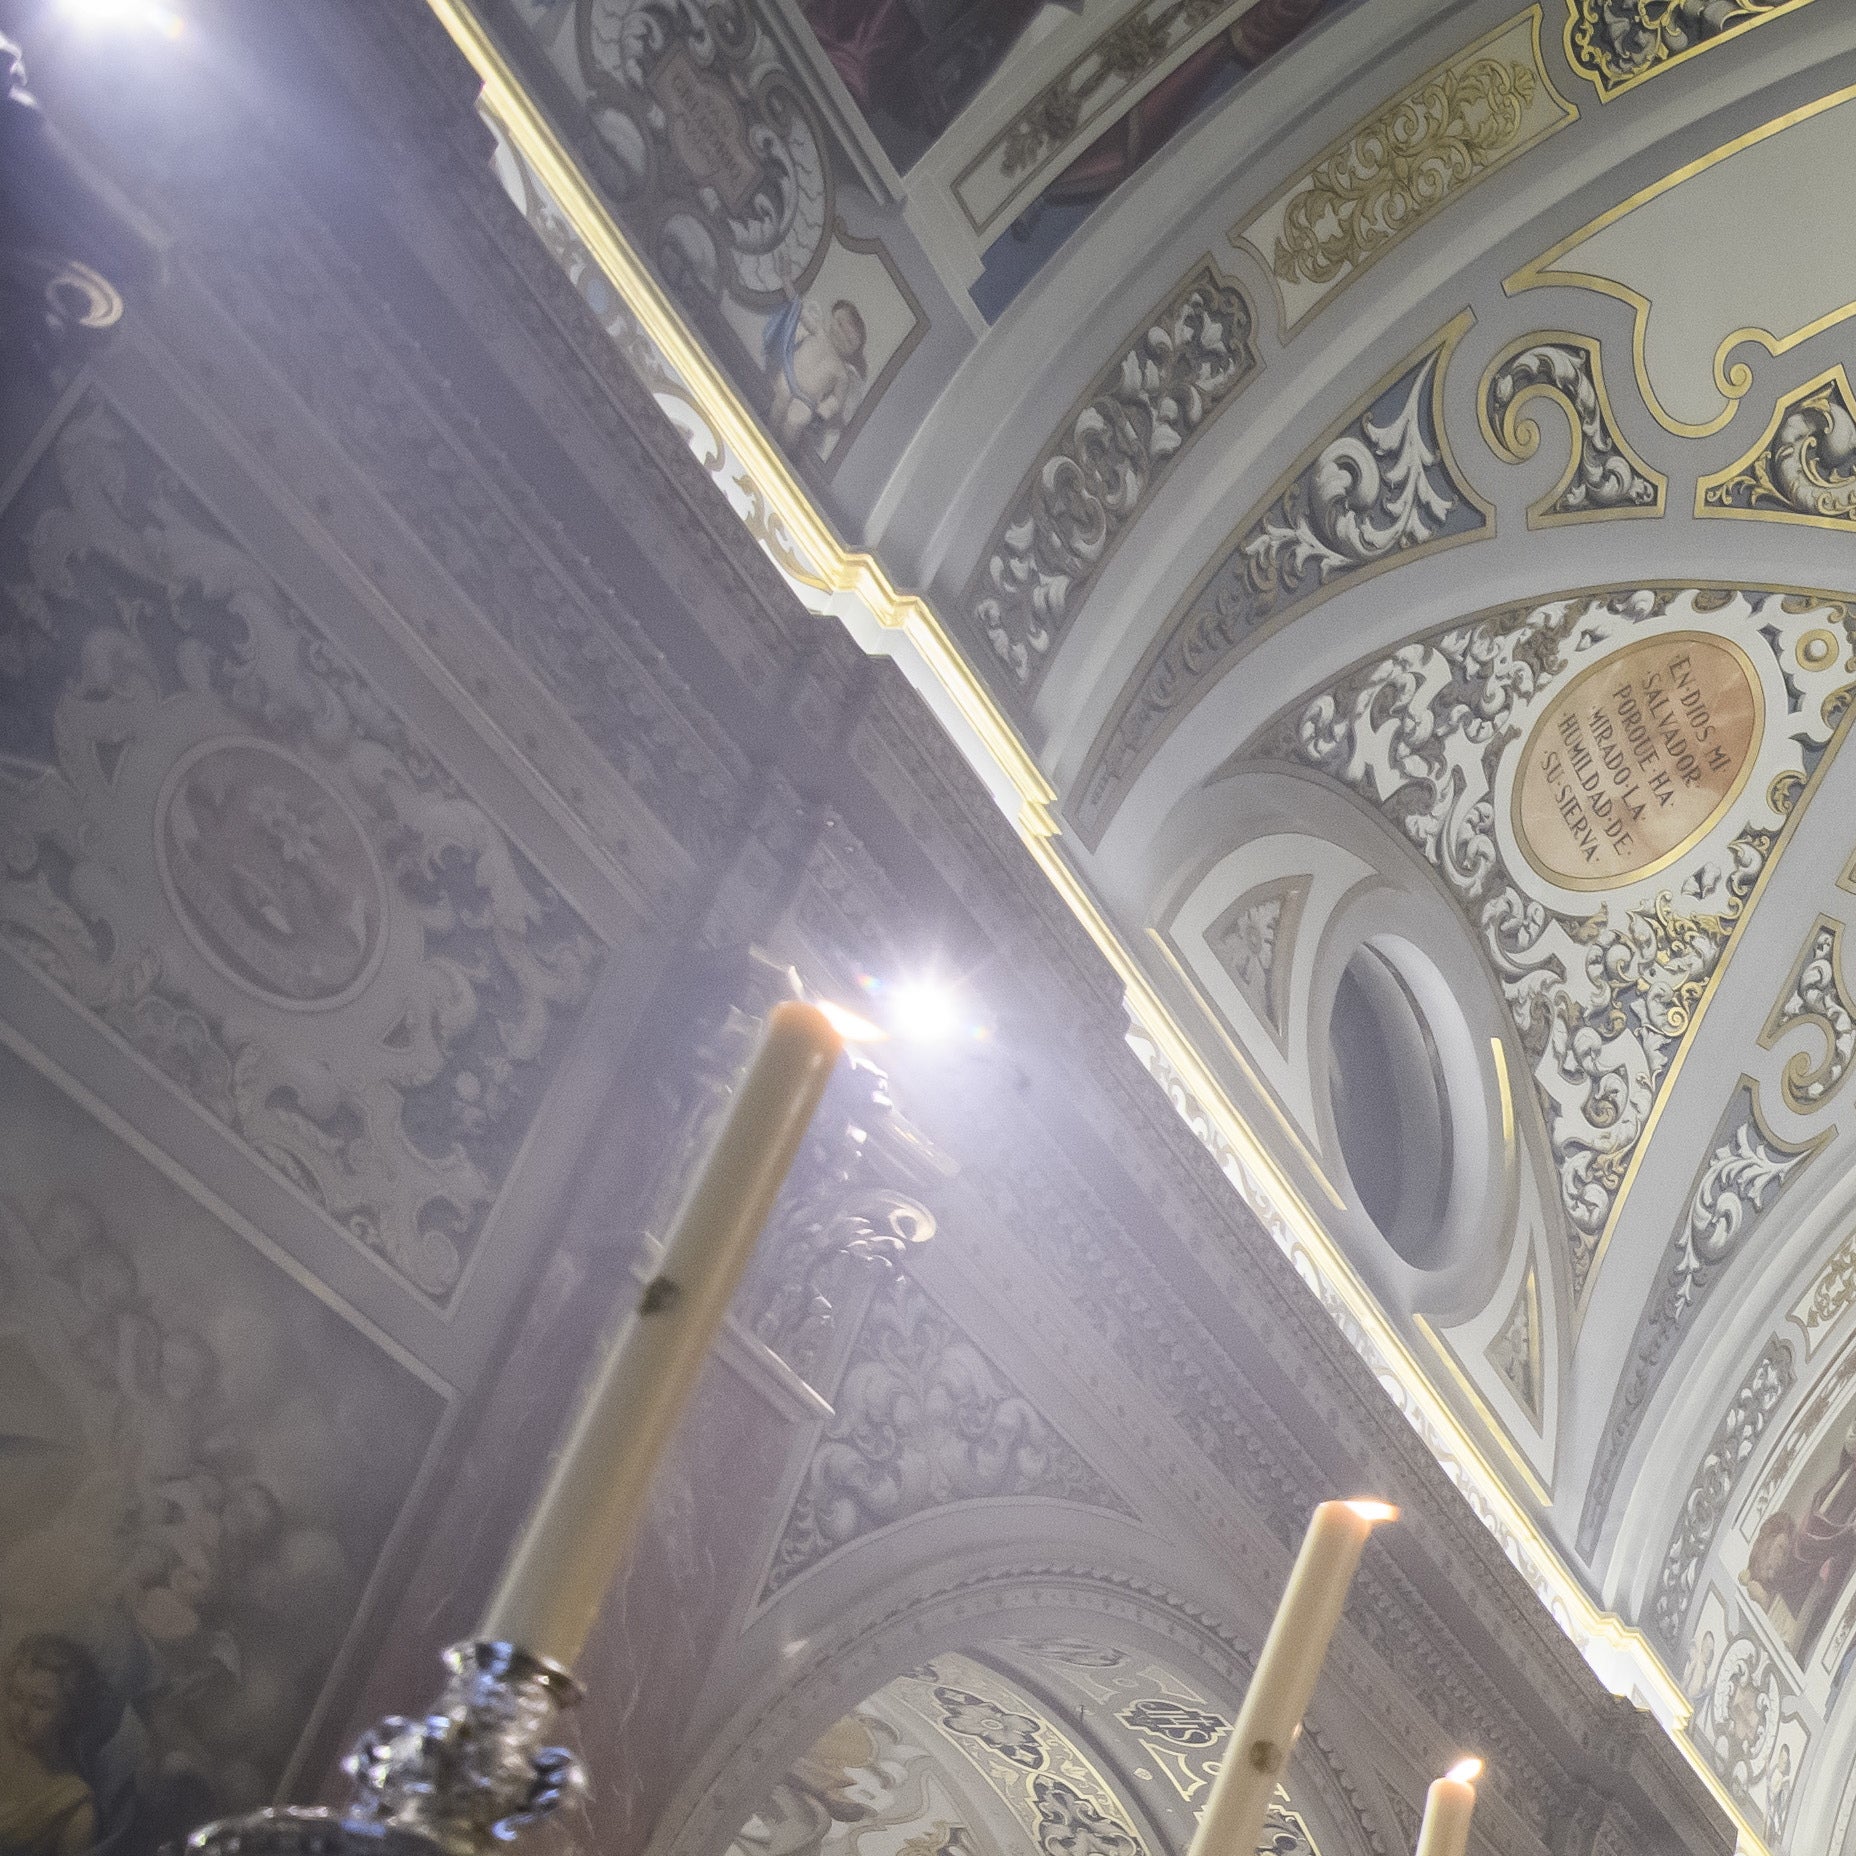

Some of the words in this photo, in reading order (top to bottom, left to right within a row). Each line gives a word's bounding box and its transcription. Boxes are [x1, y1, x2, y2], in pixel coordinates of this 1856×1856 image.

[1670, 656, 1695, 689] EN
[1644, 673, 1701, 788] SALVADOR
[1680, 689, 1715, 742] DIOS
[1559, 713, 1613, 818] HUMILDAD
[1604, 819, 1634, 856] DE
[1588, 707, 1631, 786] MIRADO
[1621, 785, 1647, 821] LA
[1648, 771, 1675, 807] HA
[1709, 746, 1731, 772] MI
[1541, 752, 1564, 784] SU
[1556, 785, 1599, 862] SIERVA
